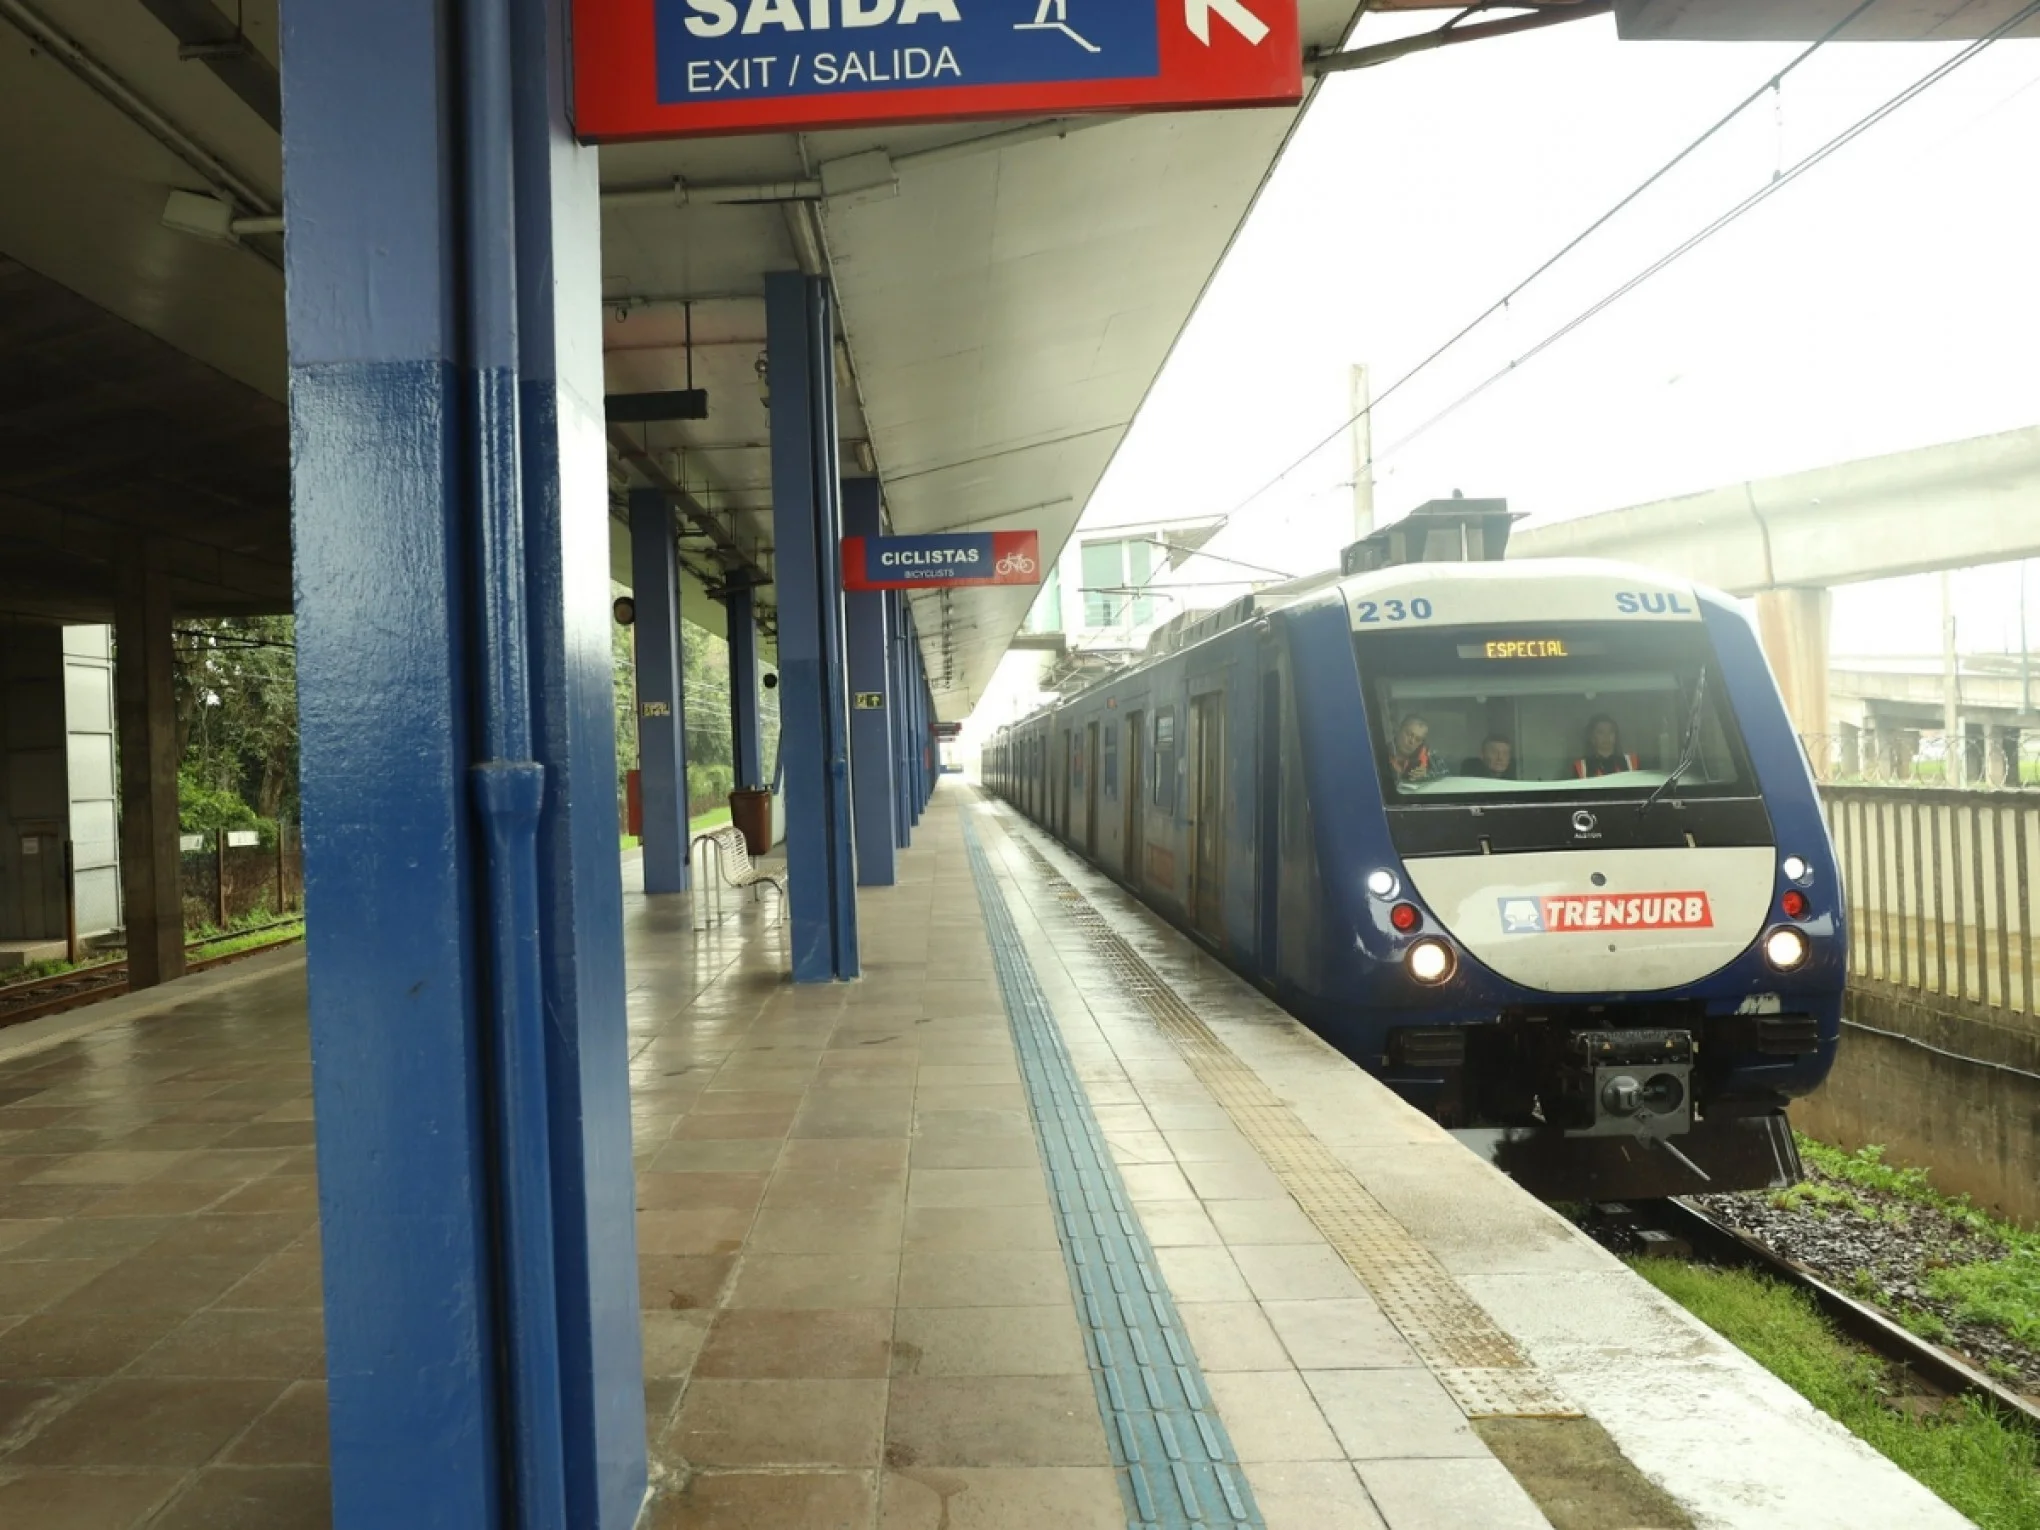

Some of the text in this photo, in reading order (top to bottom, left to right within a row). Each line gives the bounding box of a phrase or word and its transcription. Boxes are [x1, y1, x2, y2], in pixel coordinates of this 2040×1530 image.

[687, 45, 962, 93] EXIT / SALIDA
[881, 548, 979, 566] CICLISTAS
[1357, 597, 1432, 623] 230
[1615, 592, 1692, 613] SUL
[1486, 640, 1569, 658] ESPECIAL
[1547, 897, 1703, 927] TRENSURB
